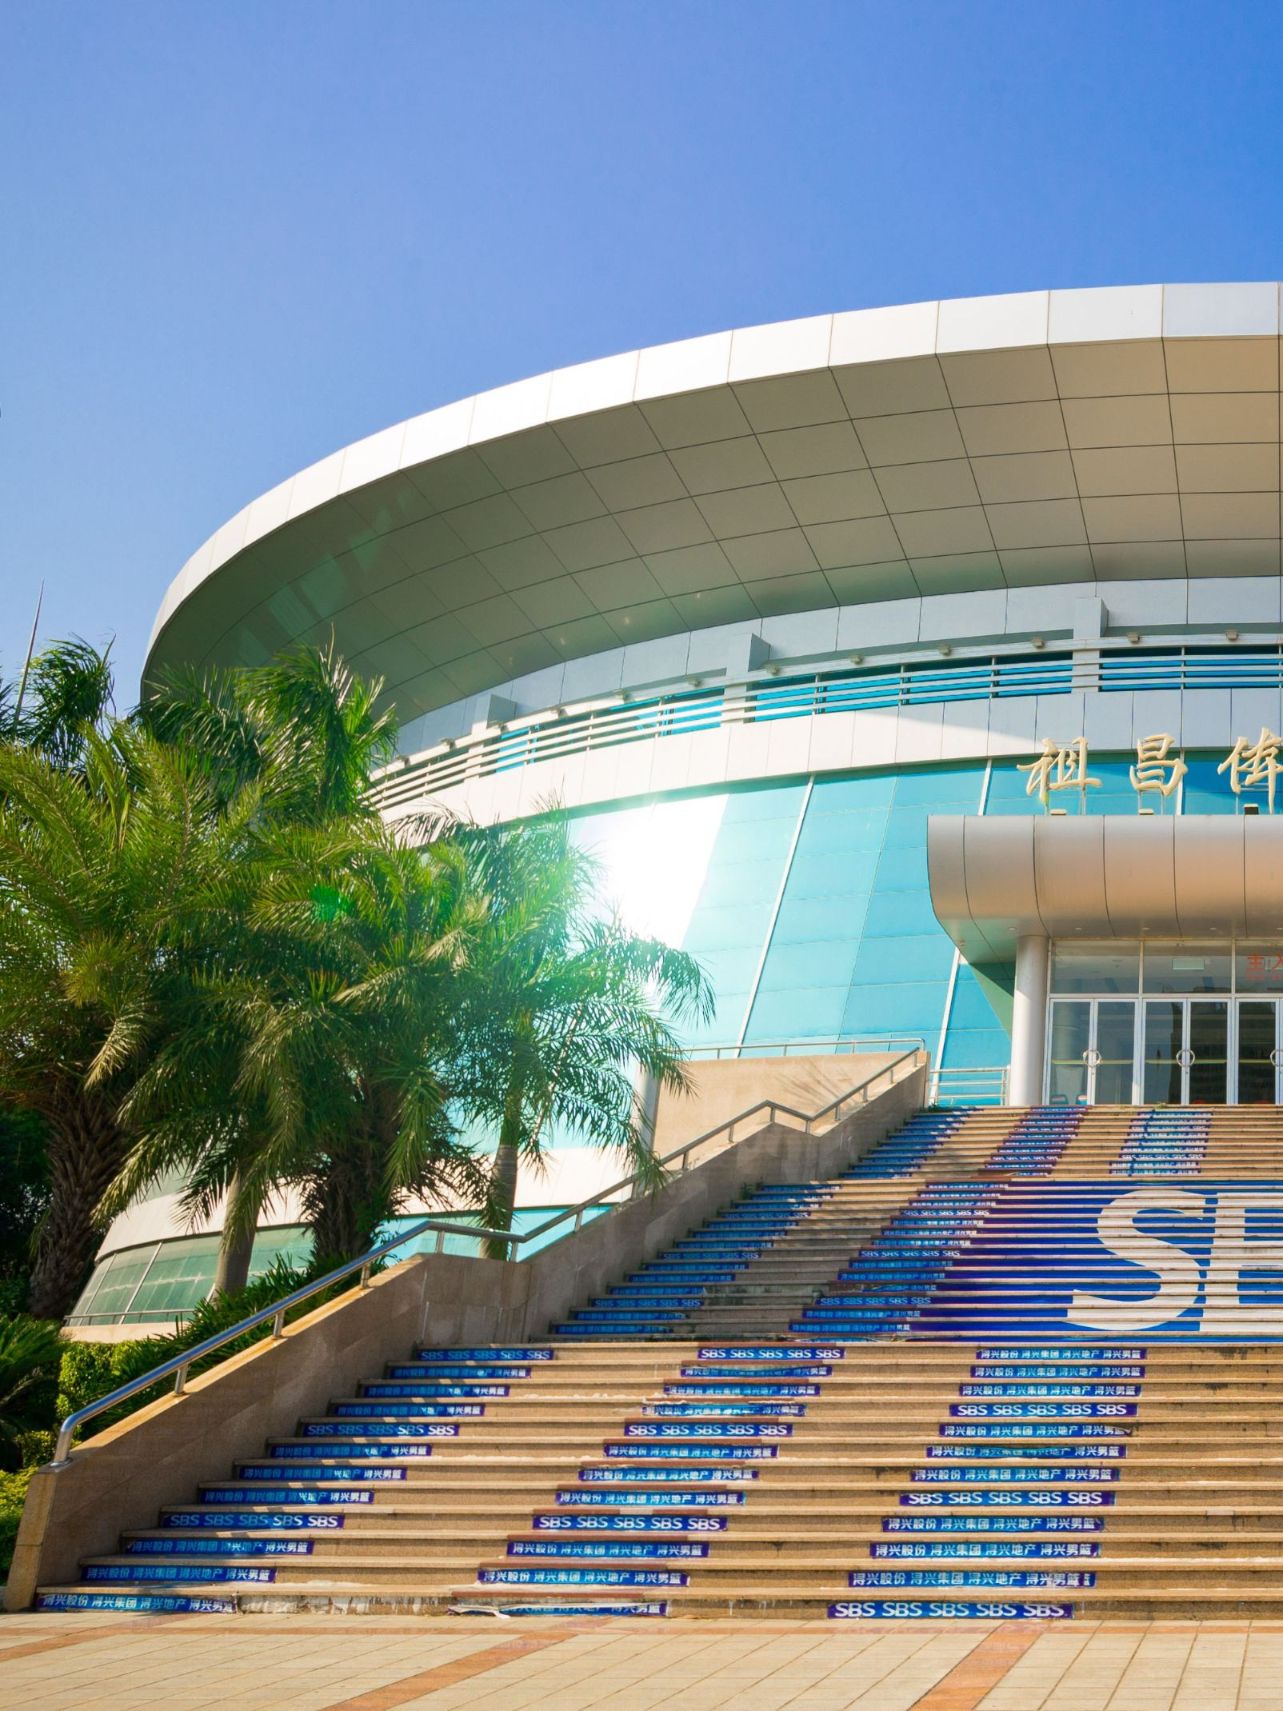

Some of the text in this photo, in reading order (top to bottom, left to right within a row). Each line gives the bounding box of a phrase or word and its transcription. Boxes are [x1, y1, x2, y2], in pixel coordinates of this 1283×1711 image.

[702, 1349, 841, 1359] SBS SBS SBS SBS SBS
[962, 1385, 1136, 1396] 浔兴股份 浔兴集团 浔兴地产 浔兴男篮
[957, 1405, 1126, 1415] SBS SBS SBS SBS SBS
[629, 1424, 788, 1436] SBS SBS SBS SBS SBS
[915, 1469, 1112, 1481] 浔兴股份 浔兴集团 浔兴地产 浔兴男篮
[908, 1492, 1102, 1505] SBS SBS SBS SBS SBS
[170, 1514, 338, 1528] SBS SBS SBS SBS SBS
[540, 1516, 720, 1530] SBS SBS SBS SBS SBS
[888, 1518, 1096, 1530] 浔兴股份 浔兴集团 浔兴地产 浔兴男篮
[875, 1544, 1091, 1557] 浔兴股份 浔兴集团 浔兴地产 浔兴男篮
[835, 1603, 1065, 1617] SBS SBS SBS SBS SBS
